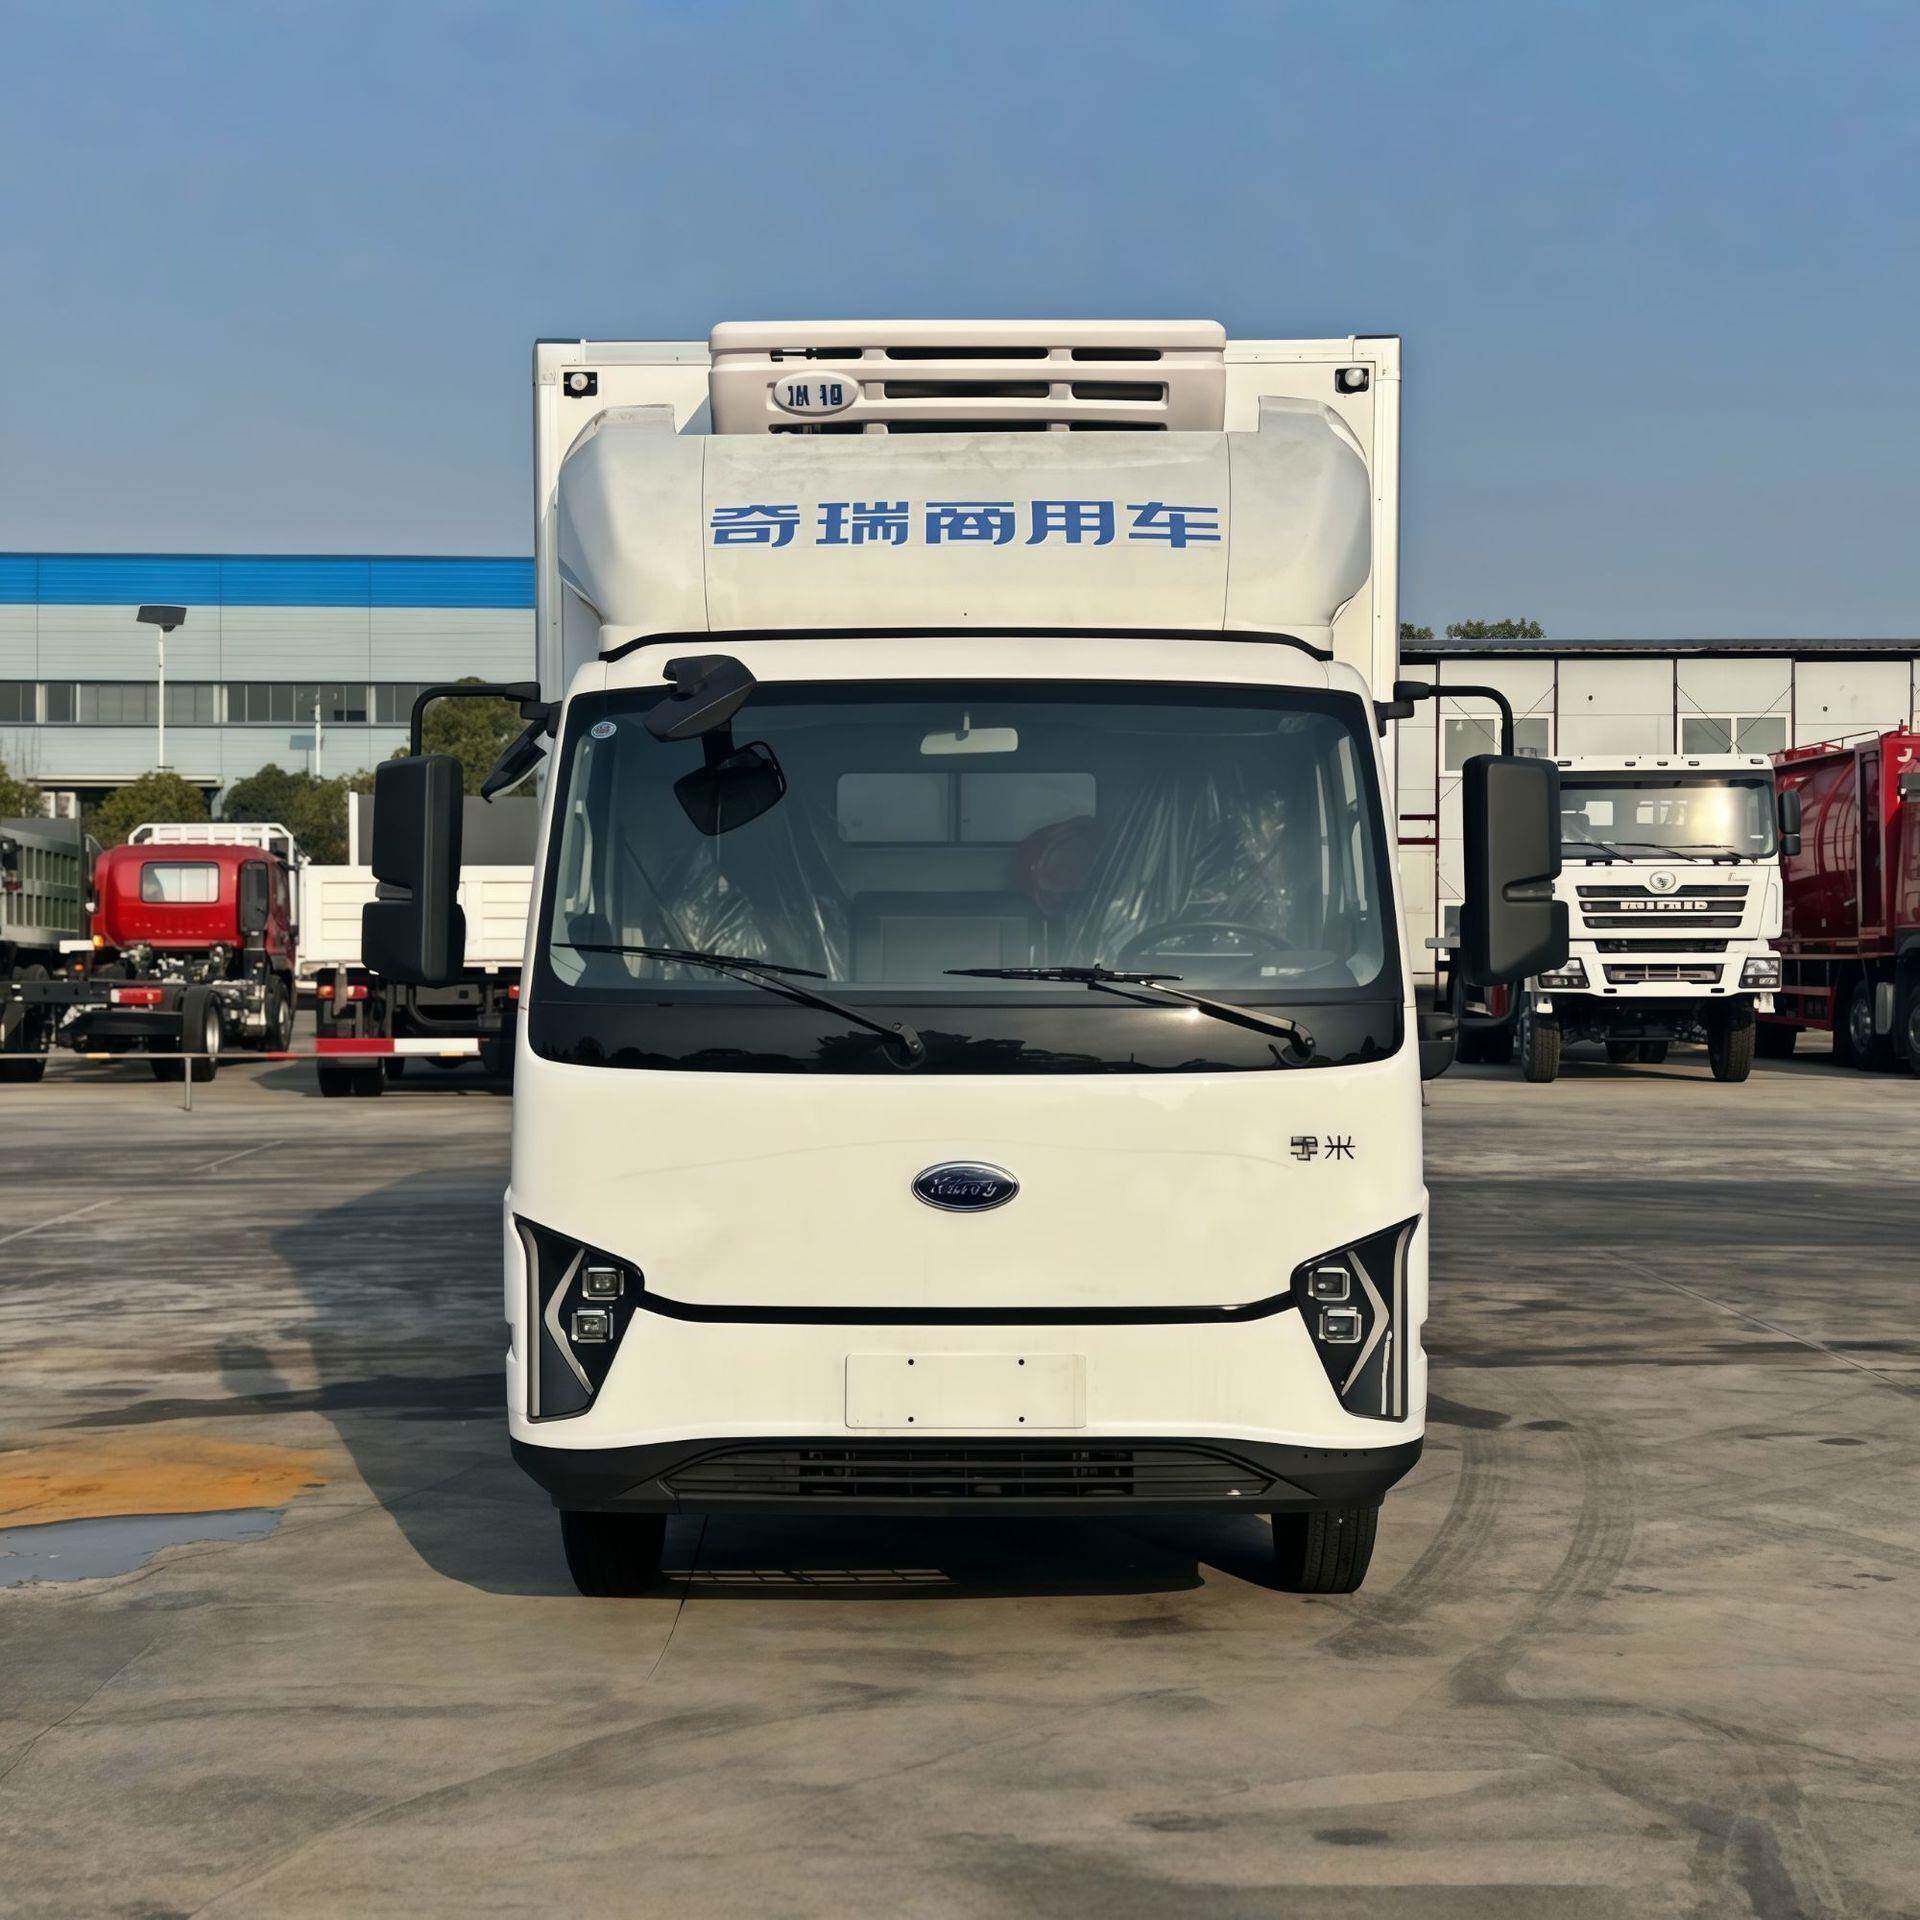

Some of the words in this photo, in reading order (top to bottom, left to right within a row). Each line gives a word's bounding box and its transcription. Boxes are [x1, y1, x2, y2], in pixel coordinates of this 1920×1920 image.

[710, 500, 1221, 549] 奇瑞商用车
